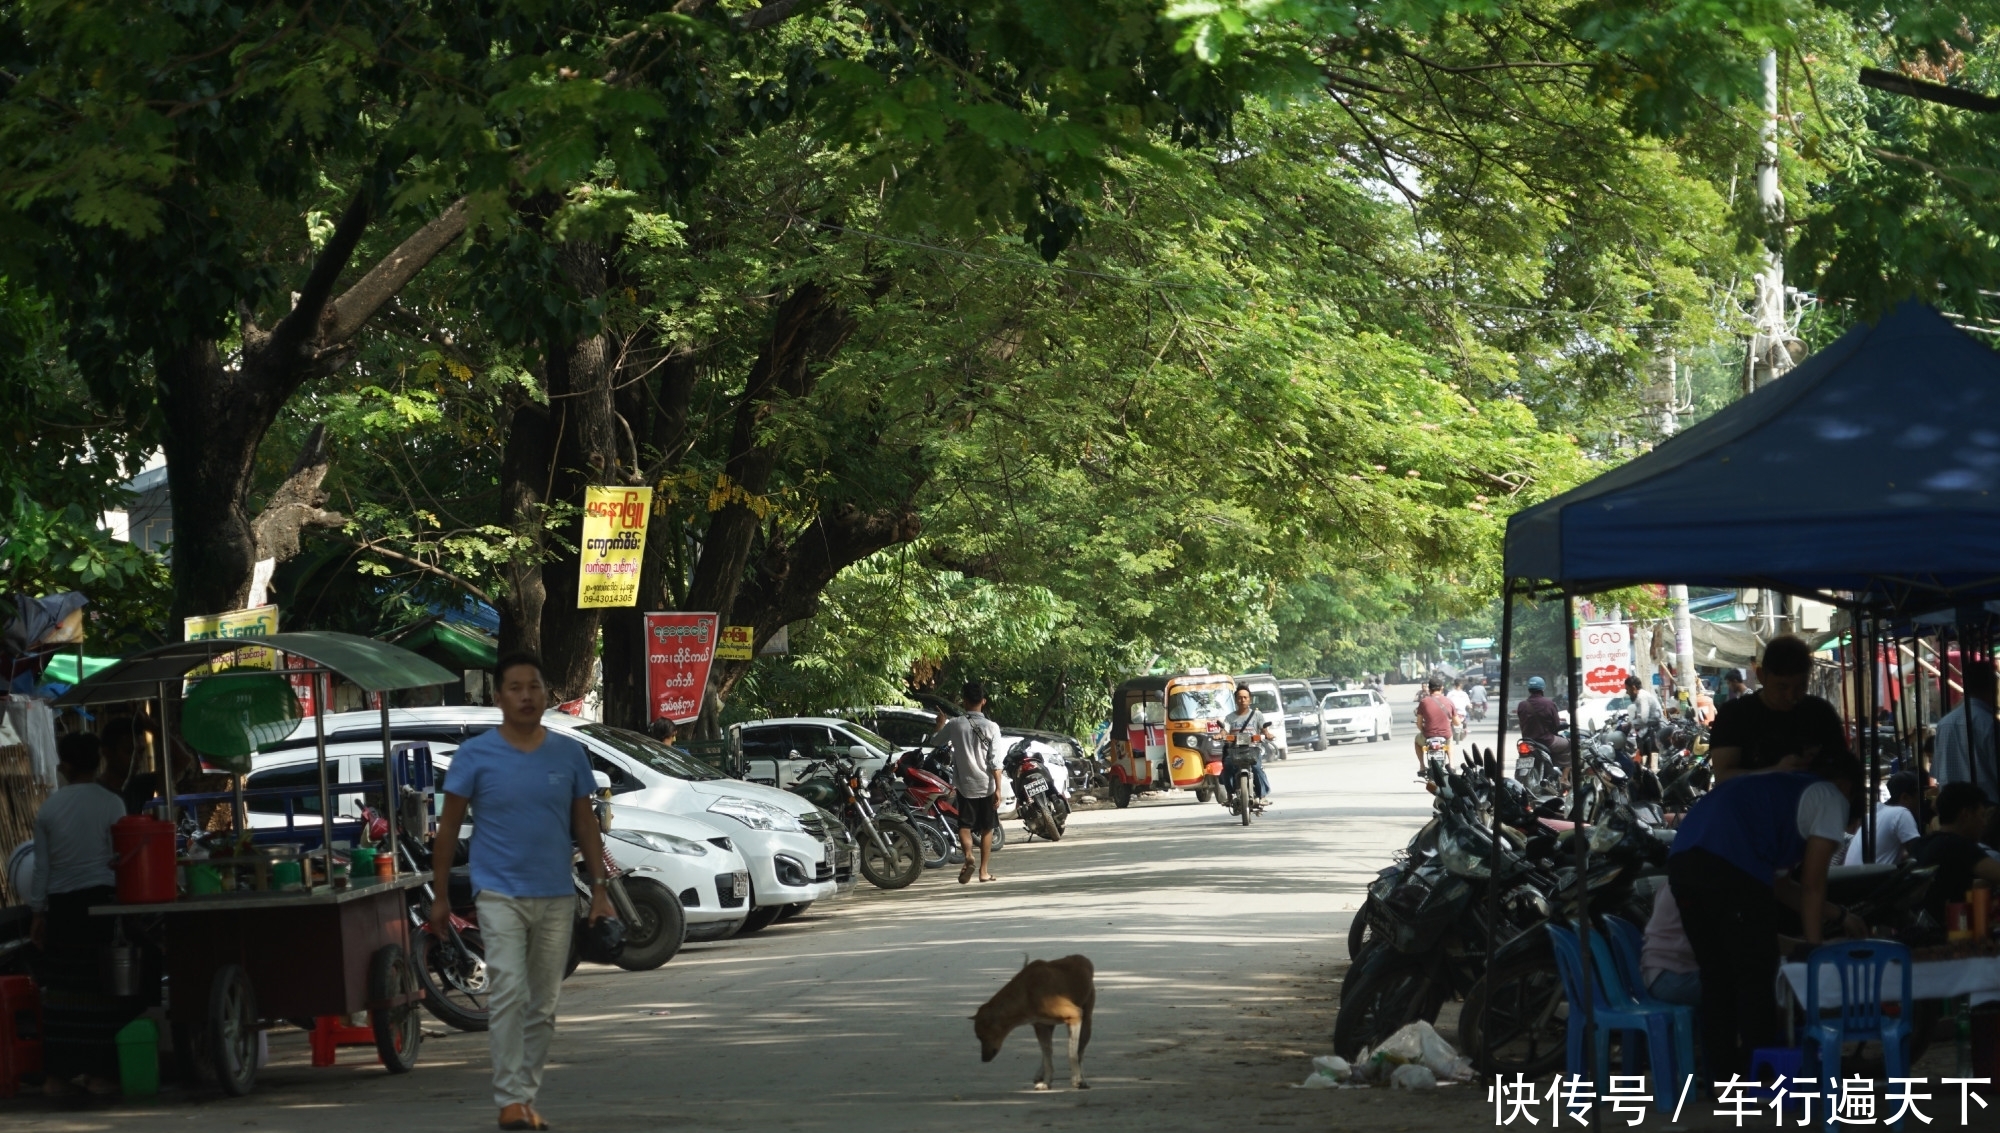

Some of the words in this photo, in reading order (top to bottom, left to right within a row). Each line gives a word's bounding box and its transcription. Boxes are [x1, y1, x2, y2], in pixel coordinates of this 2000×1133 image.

[587, 531, 642, 558] ကျောက်စိမ်း
[583, 595, 633, 604] 09-43014305
